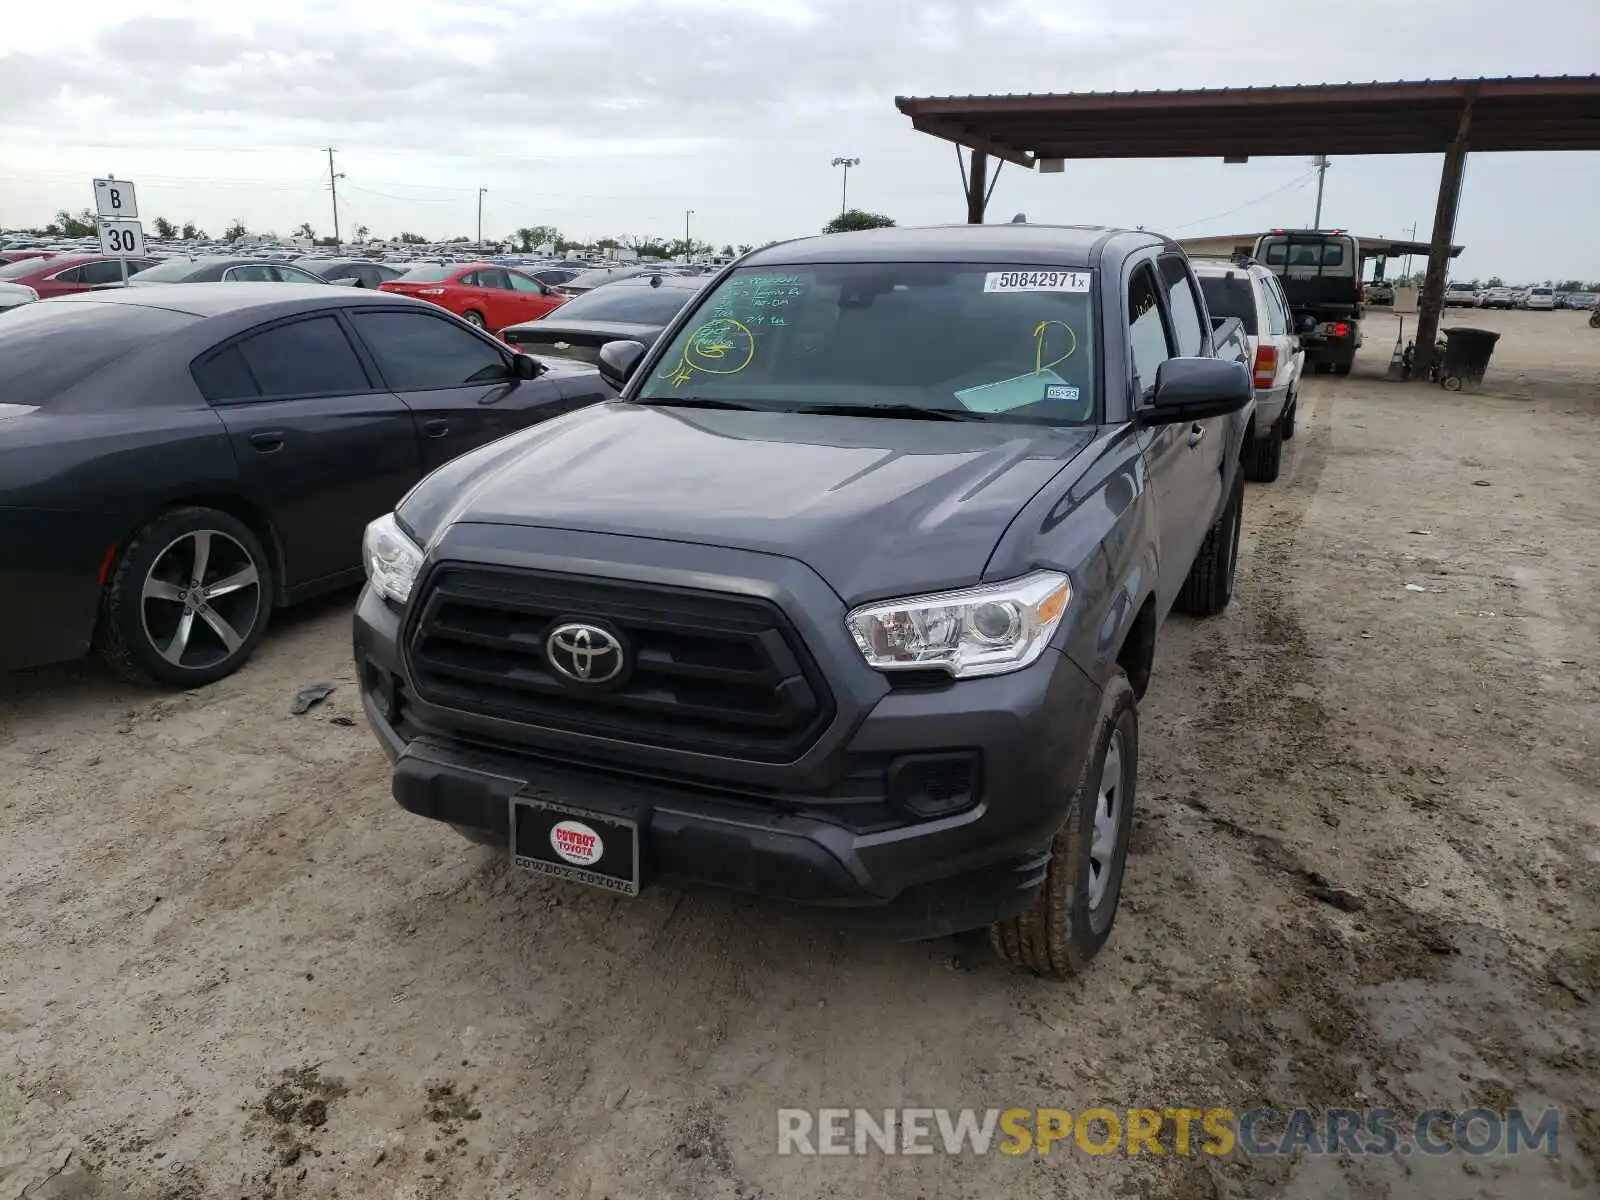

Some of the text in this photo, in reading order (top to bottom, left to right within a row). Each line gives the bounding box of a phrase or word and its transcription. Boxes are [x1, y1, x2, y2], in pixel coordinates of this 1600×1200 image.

[110, 188, 121, 209] B
[108, 229, 135, 251] 30
[556, 828, 596, 847] COWBOY
[558, 841, 594, 856] TOYOTA
